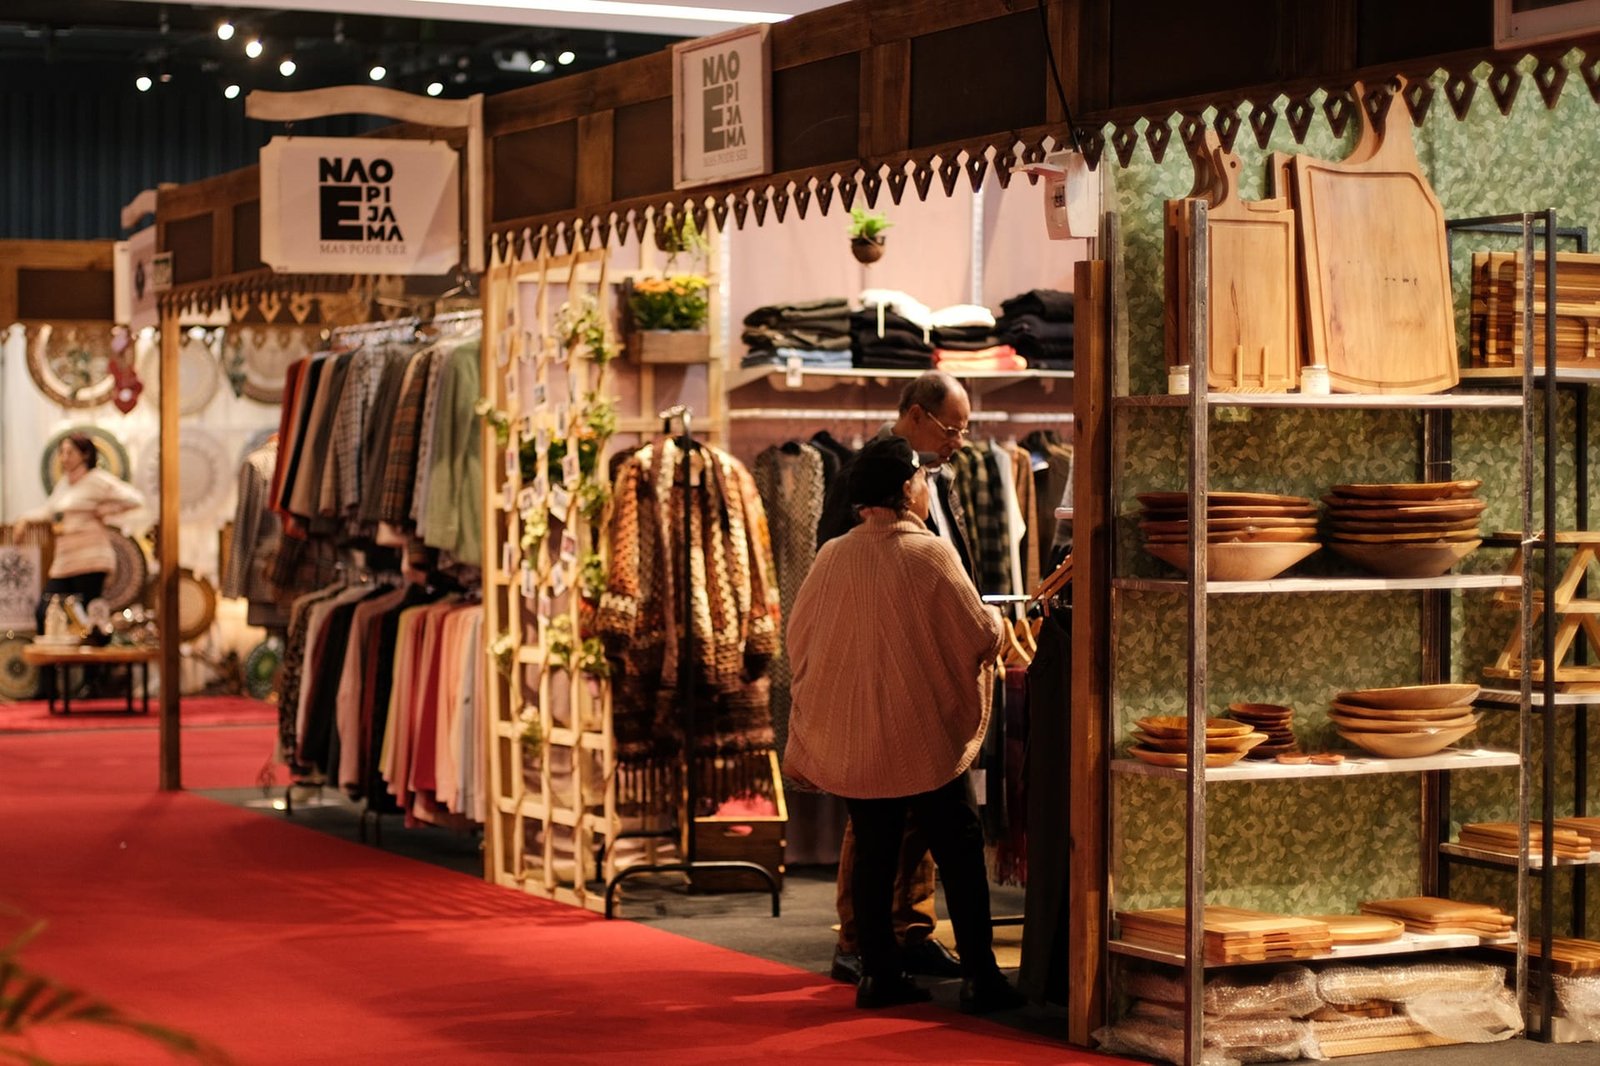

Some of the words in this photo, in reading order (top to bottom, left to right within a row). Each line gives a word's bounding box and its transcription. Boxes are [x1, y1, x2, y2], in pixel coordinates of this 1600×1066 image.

[702, 49, 740, 87] NAO
[703, 86, 725, 153] E
[319, 157, 394, 183] NAO
[320, 186, 364, 240] E
[320, 244, 345, 254] MAS
